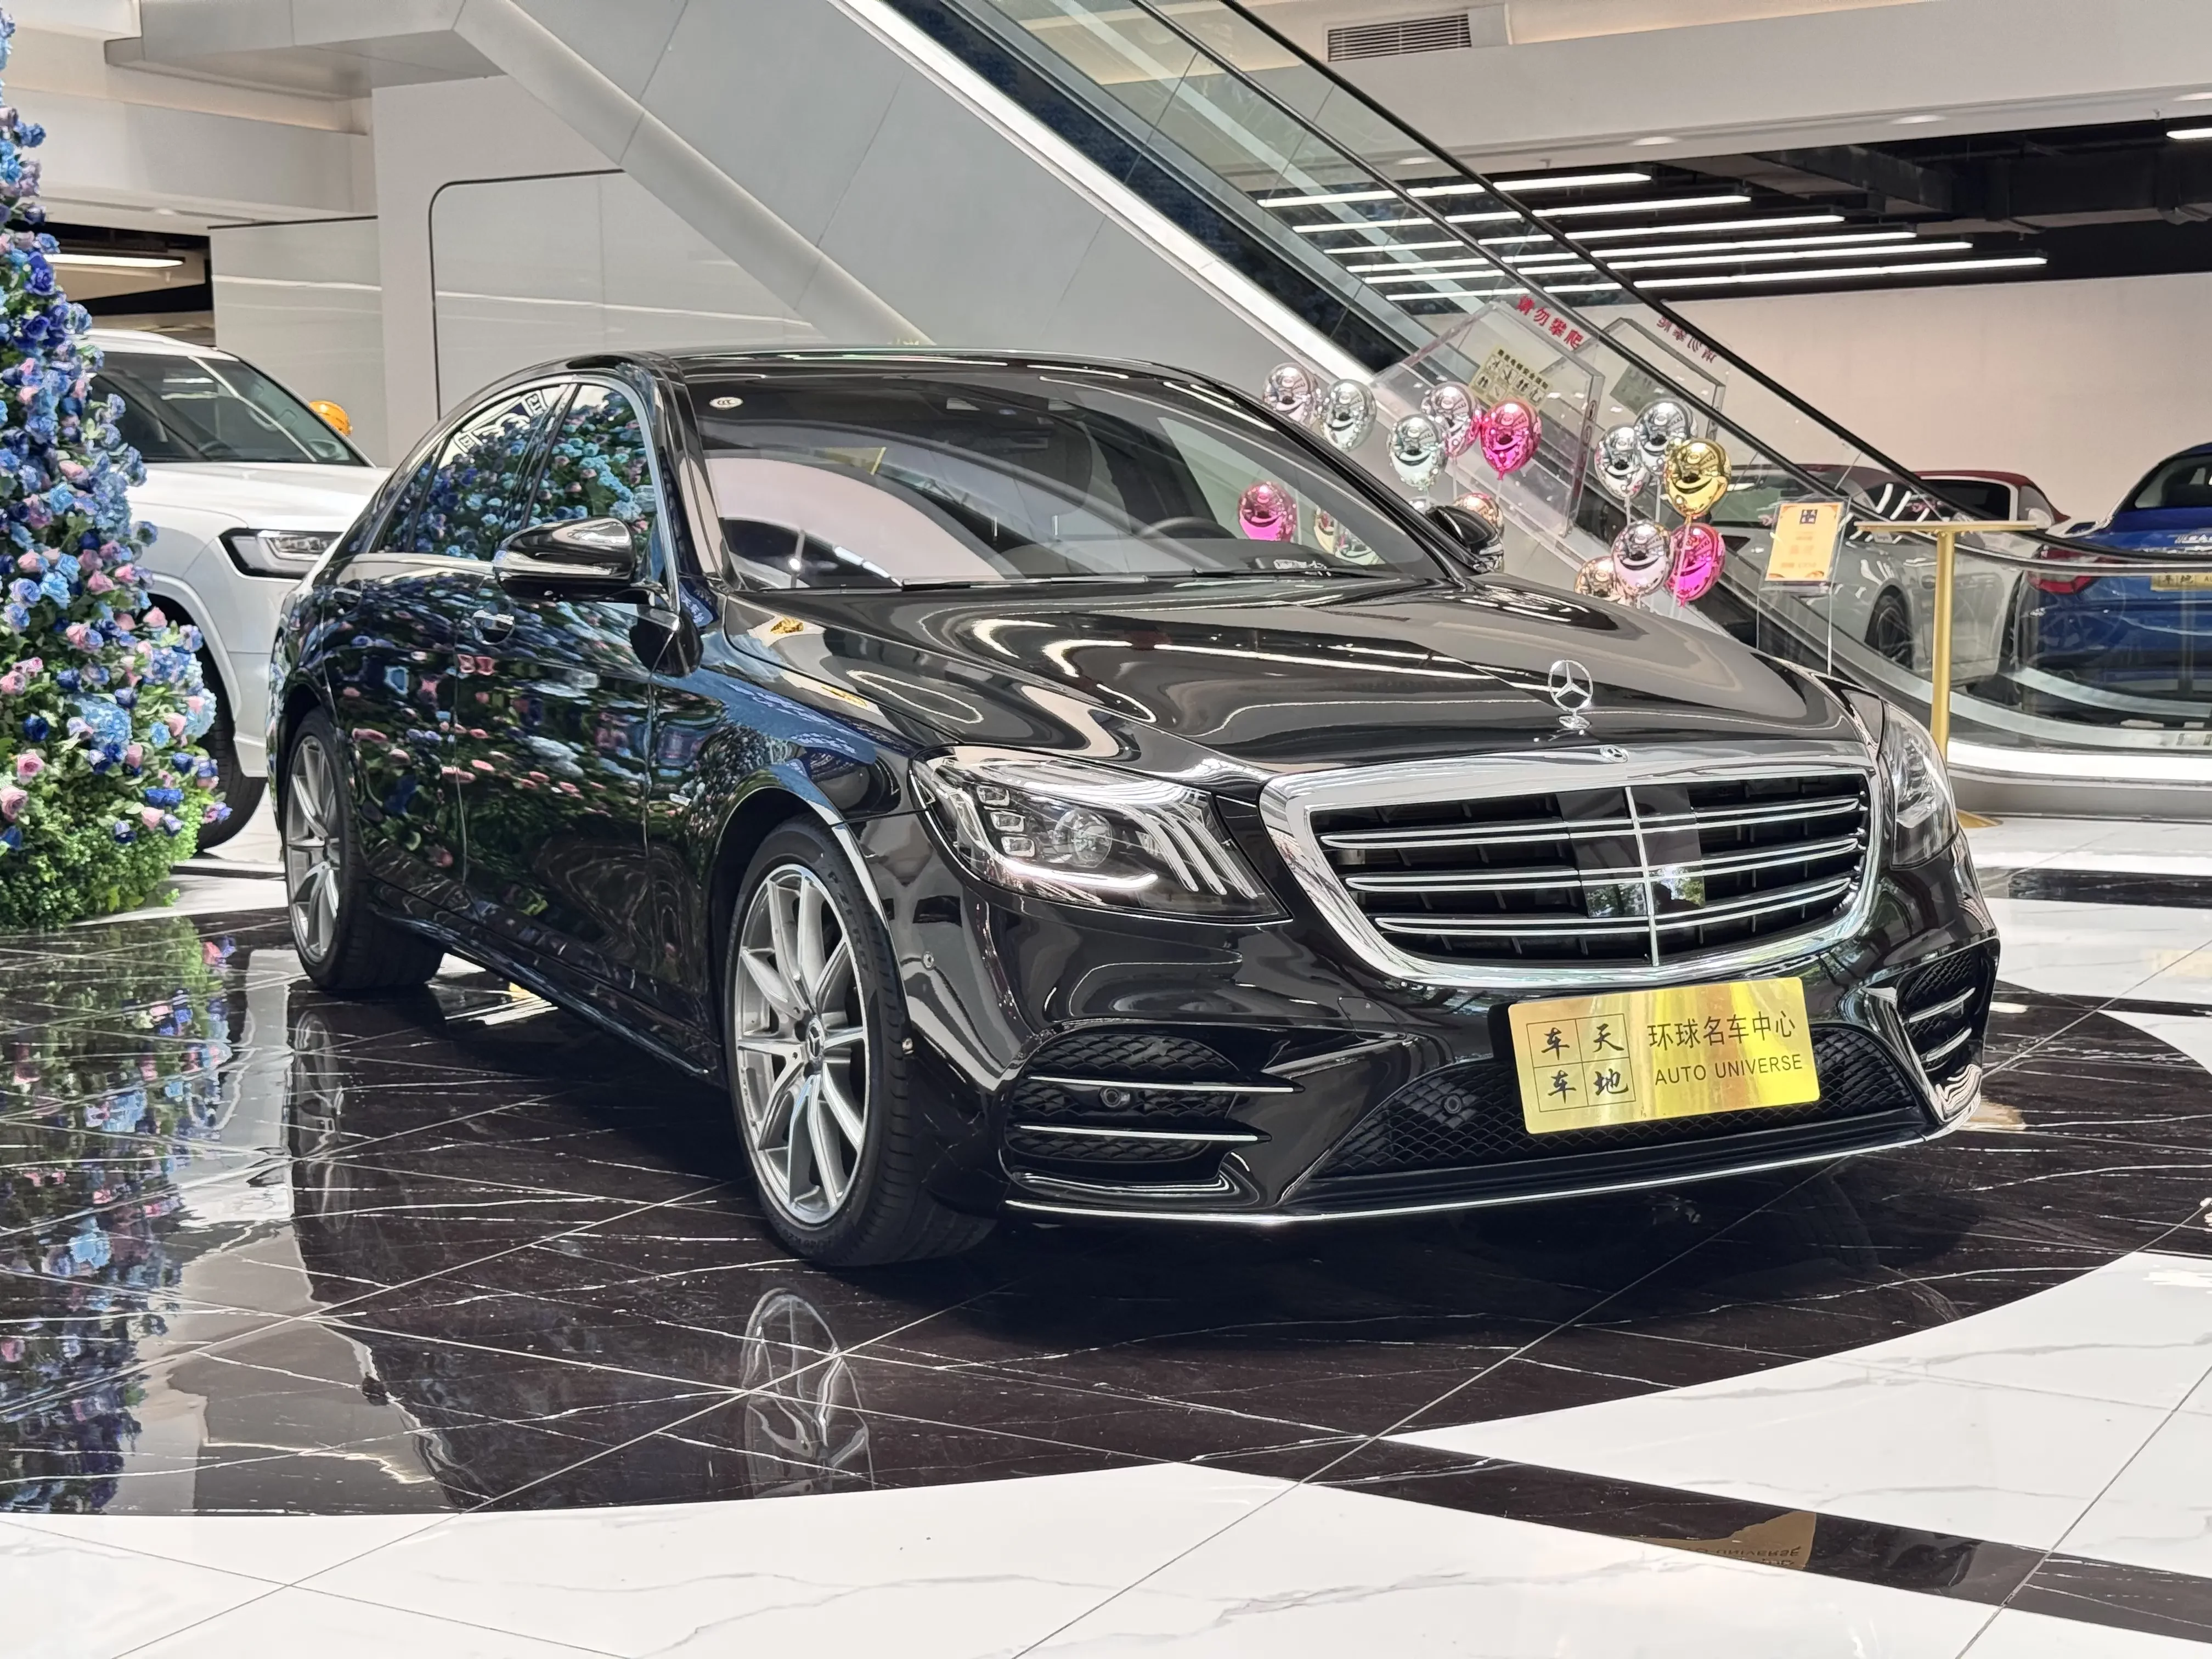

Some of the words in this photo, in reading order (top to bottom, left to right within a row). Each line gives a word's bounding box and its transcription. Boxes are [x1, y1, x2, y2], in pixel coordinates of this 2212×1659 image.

[1541, 1027, 1570, 1060] 车
[1593, 1023, 1624, 1053] 天
[1647, 1010, 1796, 1051] 环球名车中心
[1548, 1070, 1577, 1104] 车
[1593, 1068, 1629, 1096] 地
[1655, 1064, 1706, 1085] AUTO
[1715, 1053, 1803, 1079] UNIVERSE
